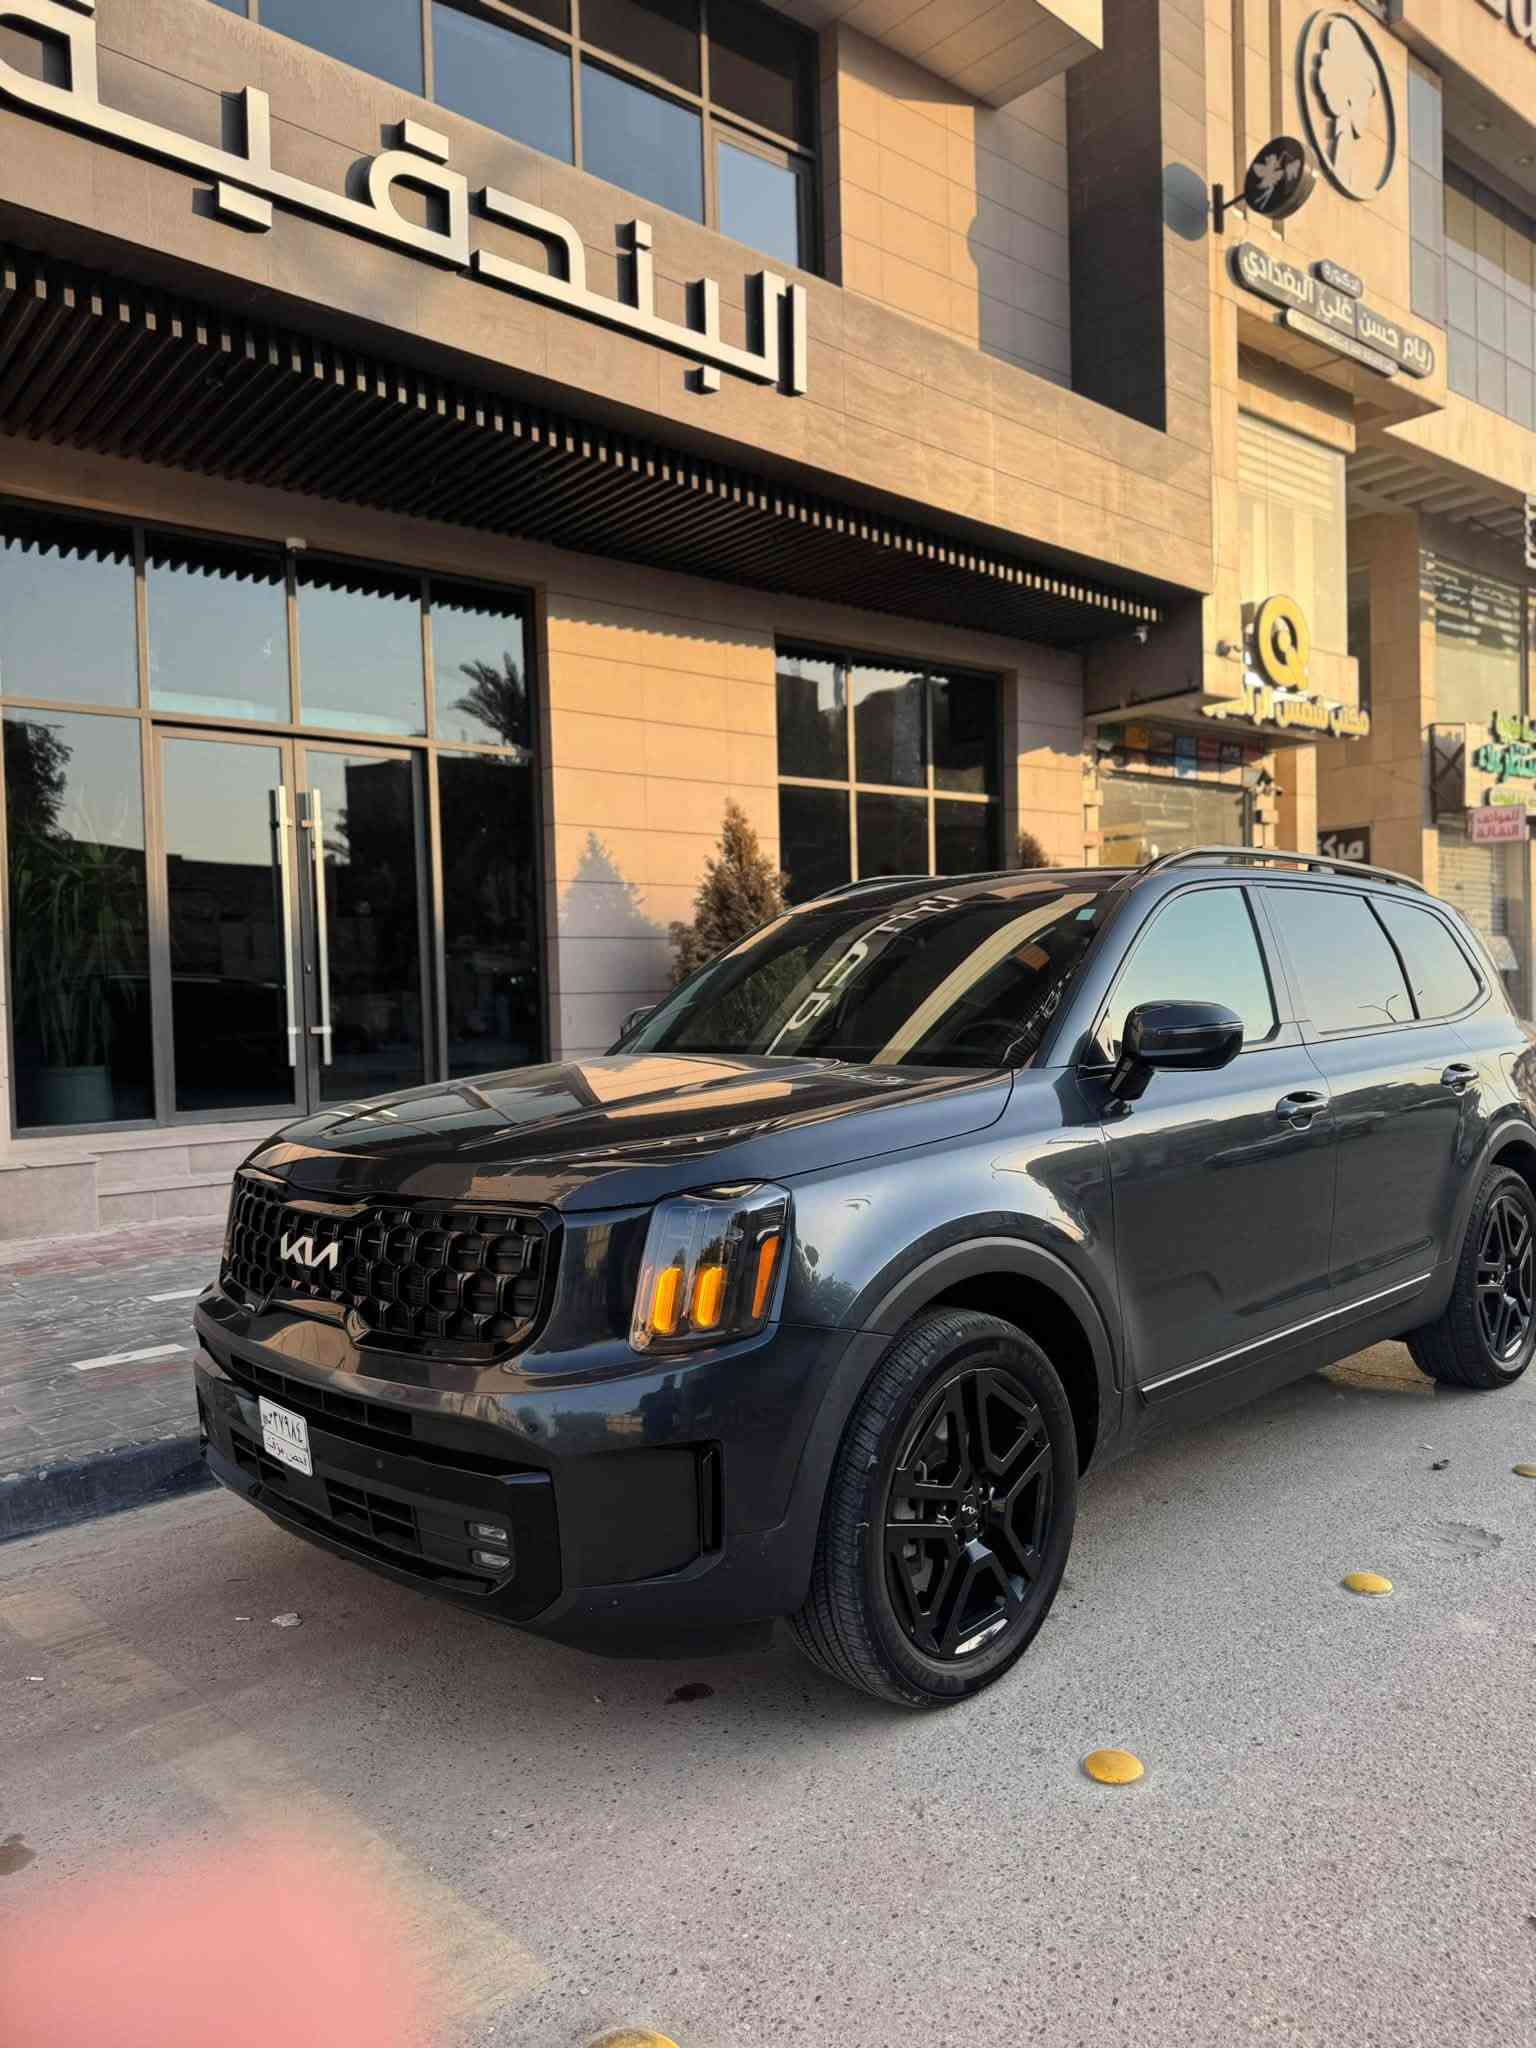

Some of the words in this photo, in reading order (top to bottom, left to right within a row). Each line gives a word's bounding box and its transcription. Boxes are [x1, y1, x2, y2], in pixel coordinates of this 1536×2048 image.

[1243, 251, 1314, 304] البغدادي
[1319, 297, 1353, 325] علي
[1359, 313, 1399, 350] حسن
[1256, 594, 1310, 691] Q
[1317, 834, 1365, 860] مرك
[280, 1231, 338, 1271] KIA
